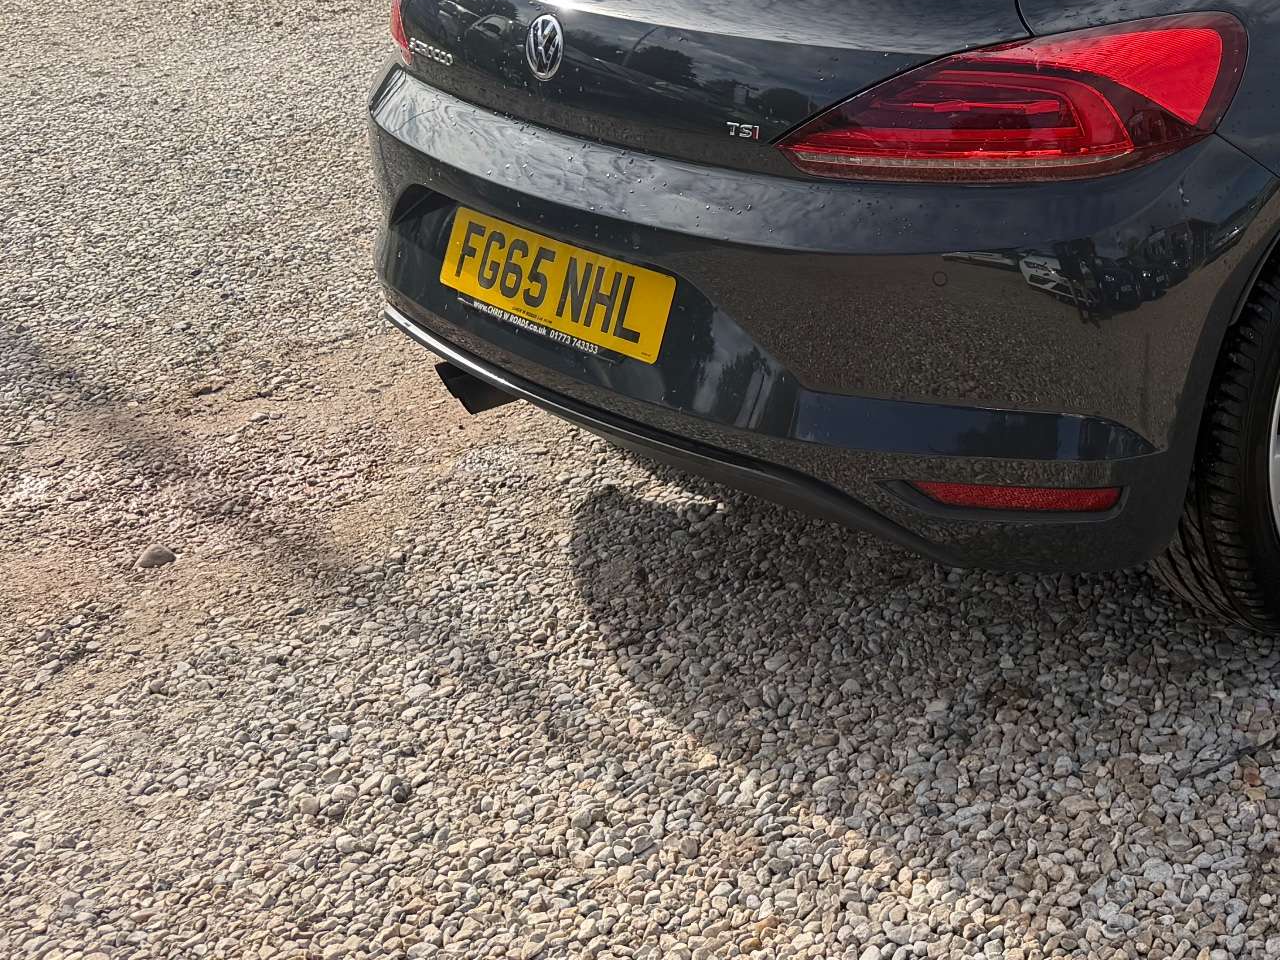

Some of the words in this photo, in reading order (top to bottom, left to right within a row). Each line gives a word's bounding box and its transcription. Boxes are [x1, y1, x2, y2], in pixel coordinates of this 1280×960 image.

[454, 220, 556, 308] FG65
[555, 256, 641, 345] NHL
[549, 329, 571, 345] 01773
[571, 337, 600, 355] 743333
